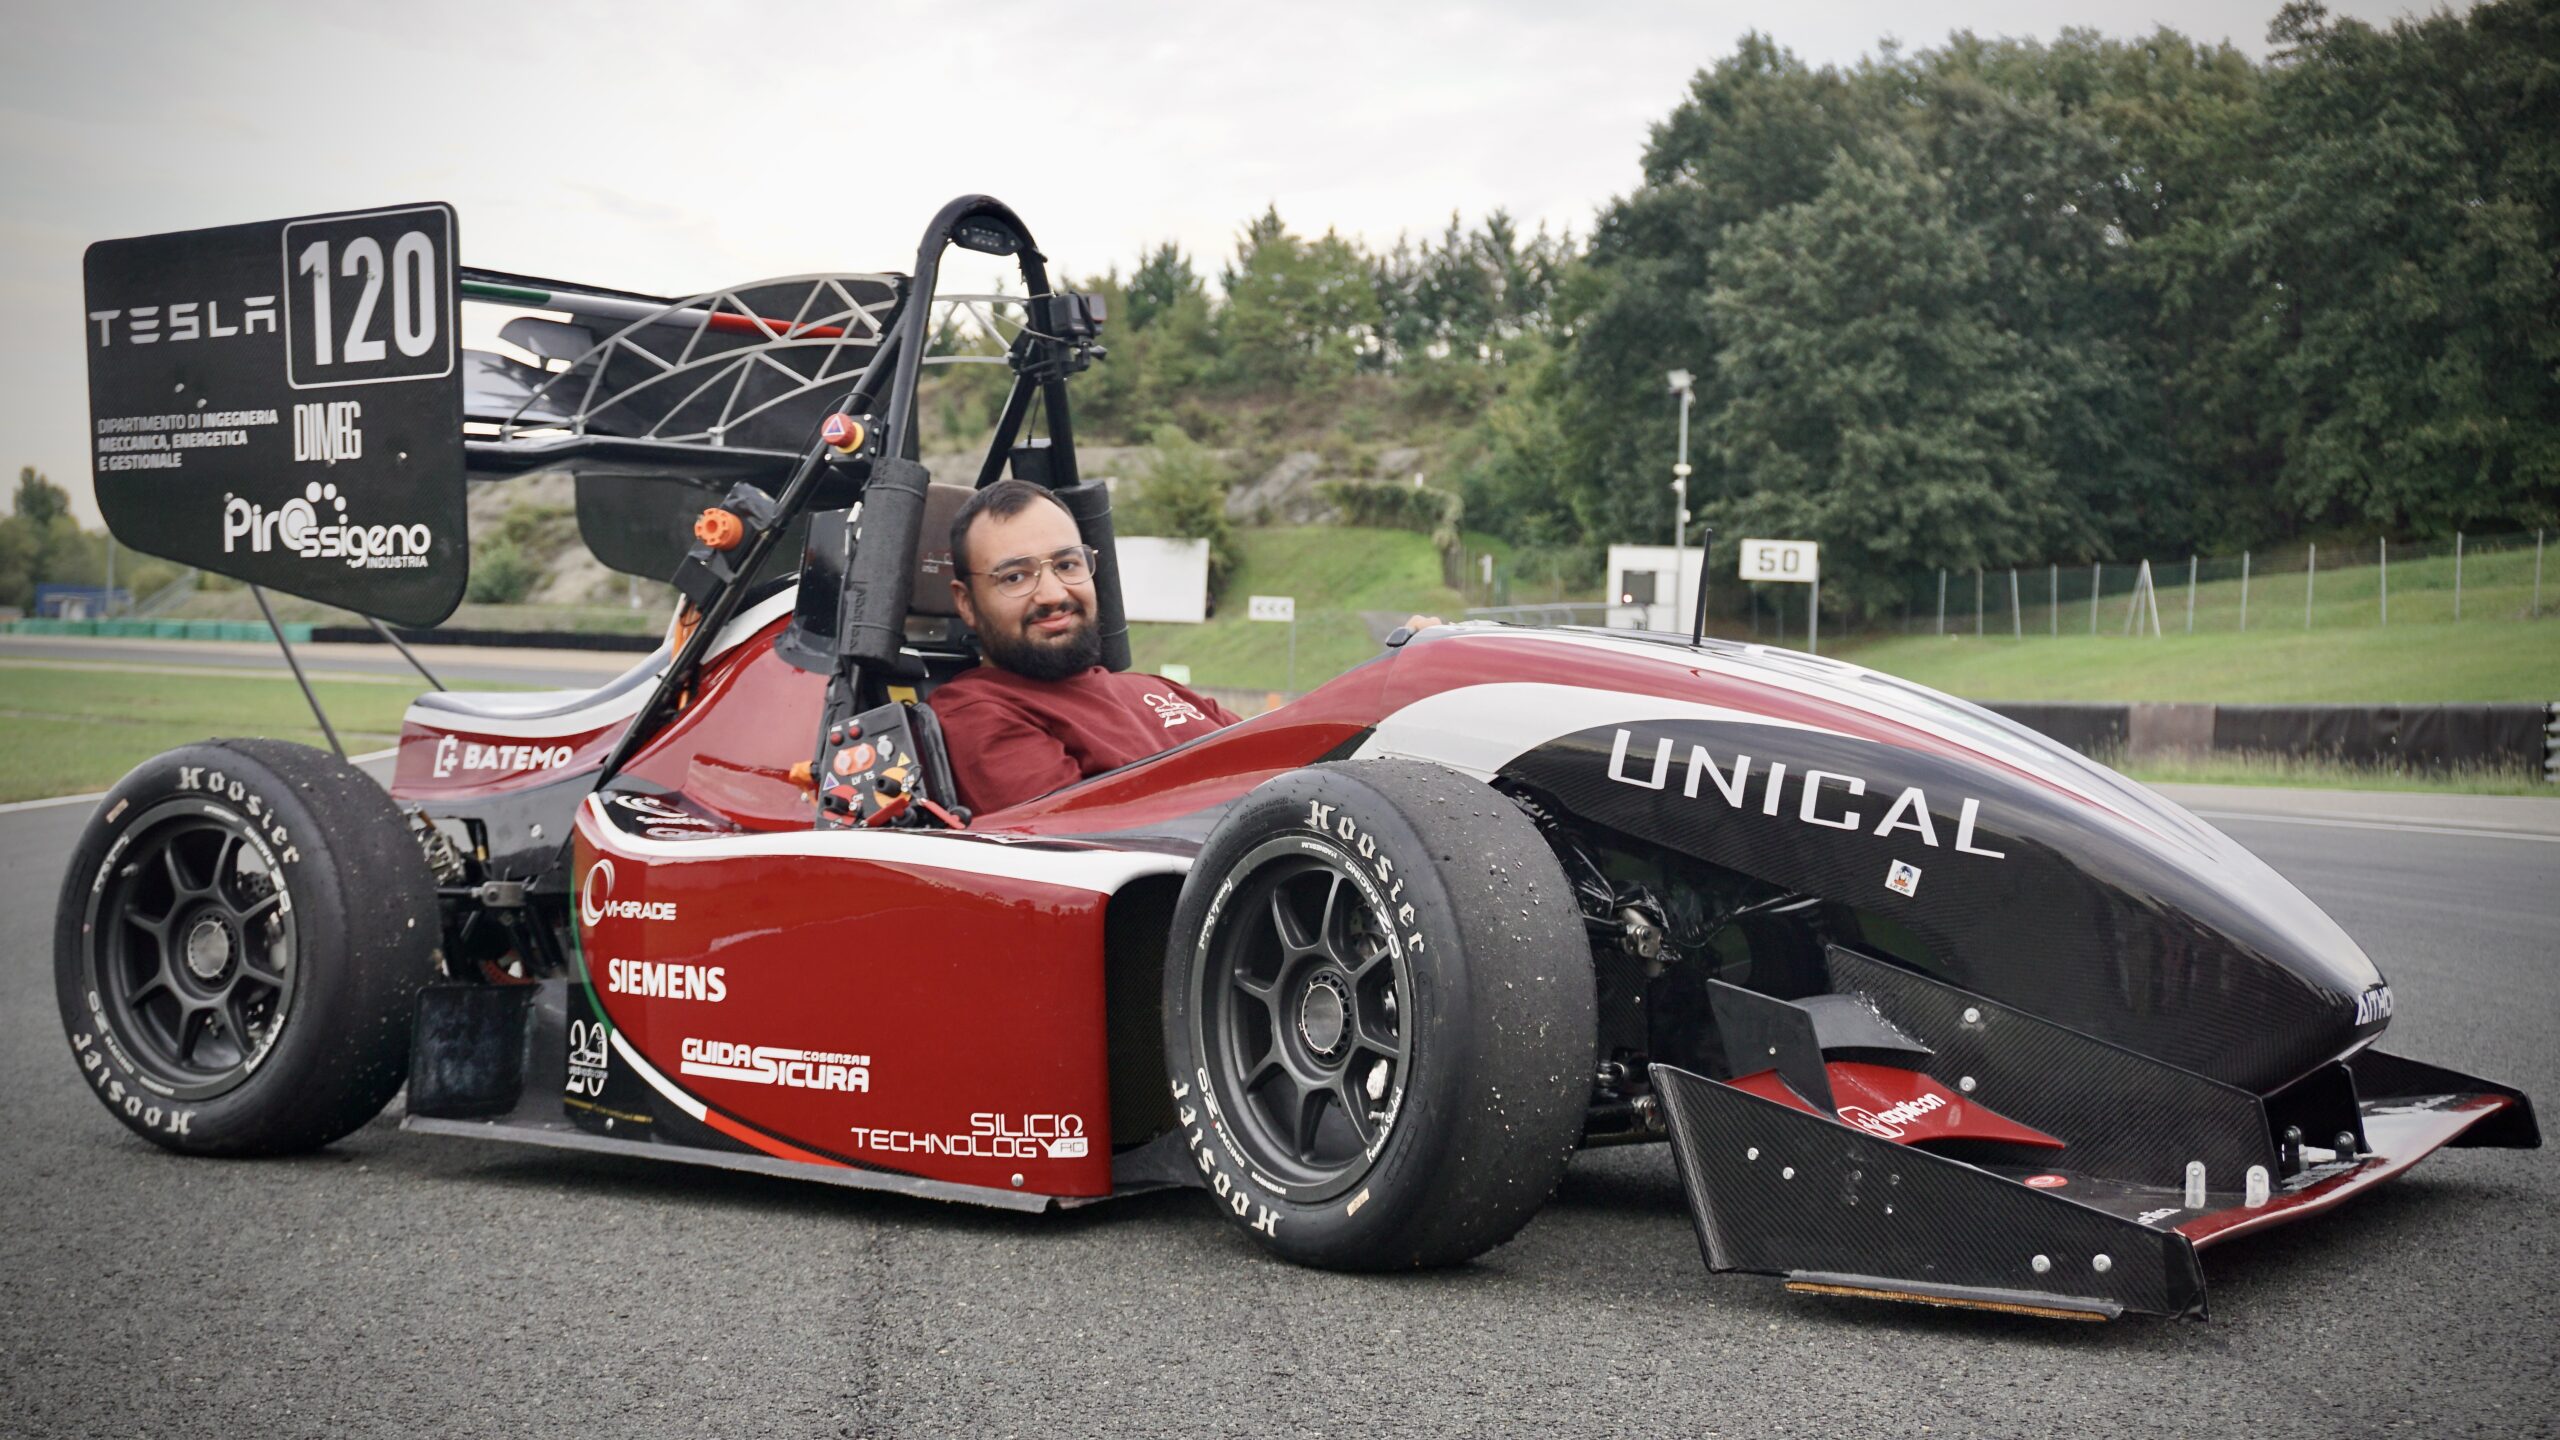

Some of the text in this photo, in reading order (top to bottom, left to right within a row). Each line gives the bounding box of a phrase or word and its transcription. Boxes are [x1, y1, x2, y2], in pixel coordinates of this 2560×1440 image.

[299, 230, 437, 367] 120
[89, 295, 276, 348] TESLA
[98, 409, 279, 434] DIPARTIMENTO DI INGEGNERIA
[98, 430, 248, 452] MECCANICA, ENERGETICA
[293, 401, 361, 462] DIMEG
[99, 452, 182, 472] E GESTIONALE
[366, 555, 428, 568] INDUSTRIA
[1756, 547, 1800, 574] 50
[463, 745, 573, 770] BATEMO
[176, 766, 300, 865] Hoosier
[1607, 728, 2005, 859] UNICAL
[1304, 799, 1425, 955] Hoosier
[1344, 861, 1378, 905] RACING
[605, 899, 677, 922] VI-GRADE
[608, 957, 727, 1003] SIEMENS
[803, 1050, 860, 1066] COSENZA
[72, 1033, 196, 1136] Hoosier
[1877, 1092, 1946, 1125] applicon
[851, 1127, 1056, 1158] TECHNOLOGY
[1170, 1080, 1285, 1238] Hoosier
[1214, 1121, 1245, 1168] RACING
